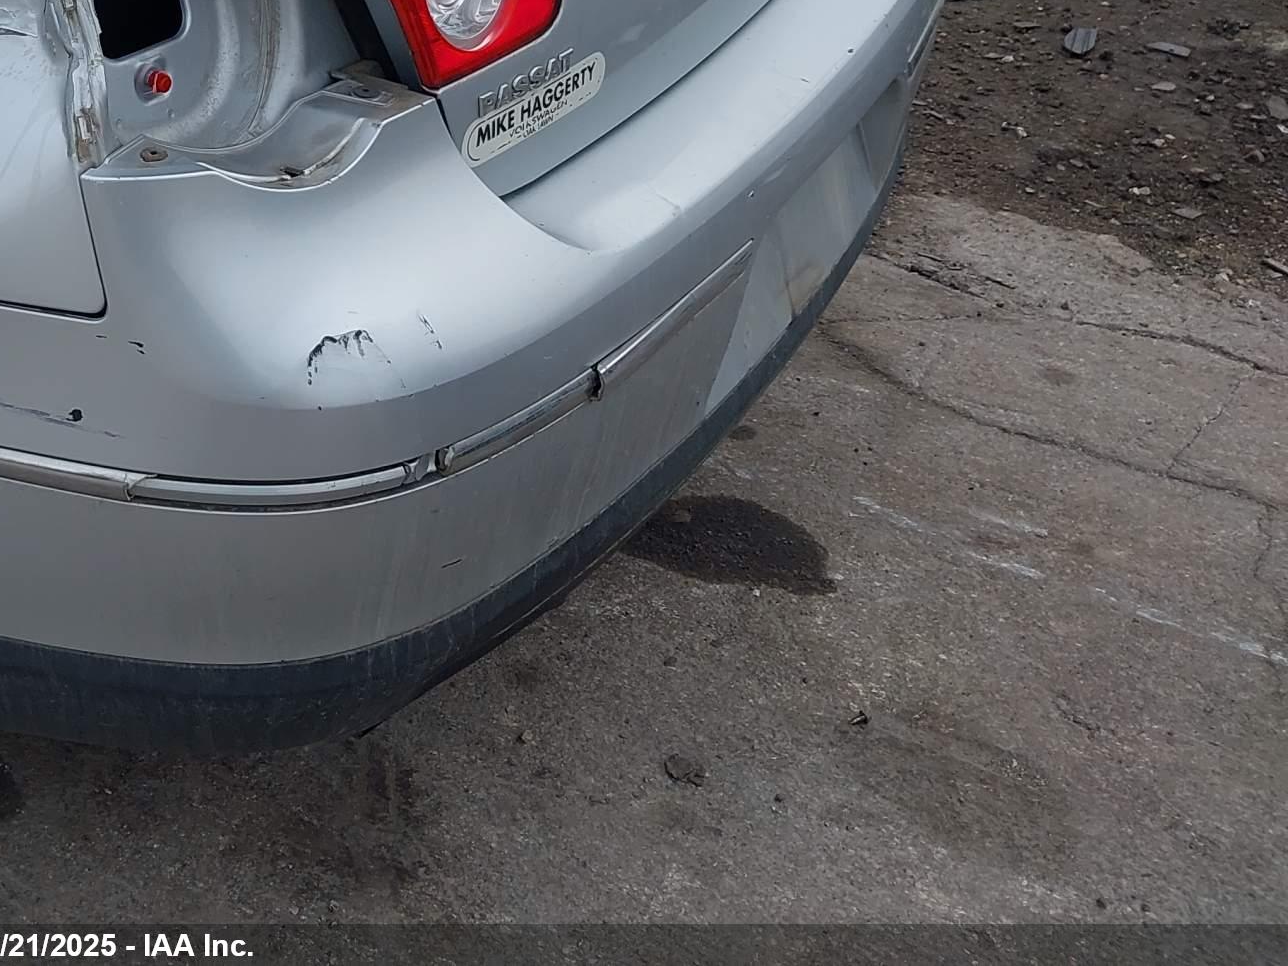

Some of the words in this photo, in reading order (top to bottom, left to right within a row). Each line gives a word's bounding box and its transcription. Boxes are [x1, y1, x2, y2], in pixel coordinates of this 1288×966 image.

[475, 108, 516, 148] MIKE
[519, 60, 597, 122] HAGGERTY
[478, 47, 574, 119] PASSAT
